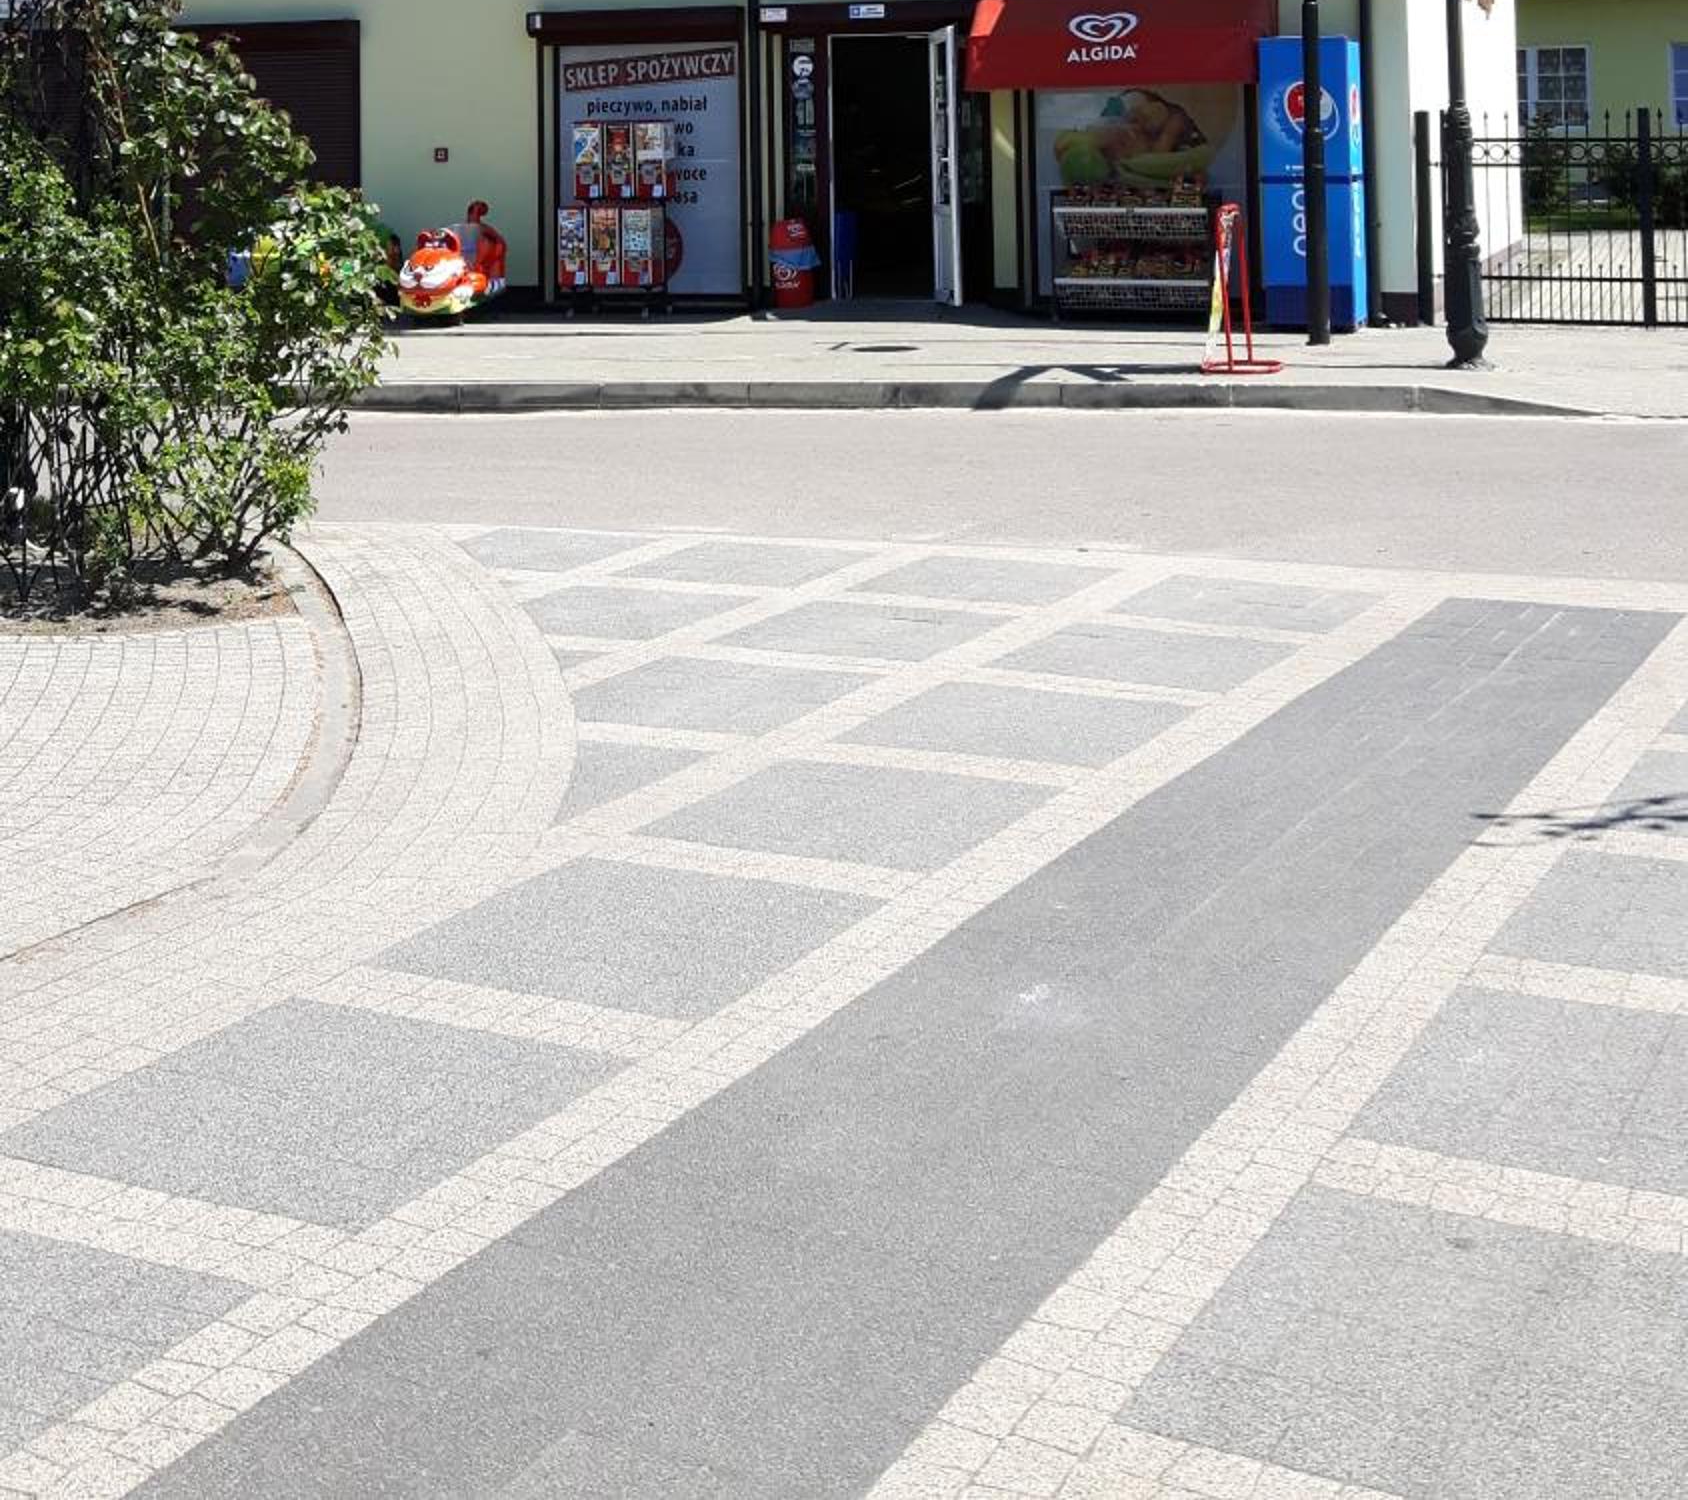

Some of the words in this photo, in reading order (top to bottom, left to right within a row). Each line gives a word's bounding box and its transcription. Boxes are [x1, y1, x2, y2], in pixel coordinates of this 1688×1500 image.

[1067, 44, 1137, 63] ALGIDA
[566, 64, 619, 89] SKLEP
[626, 51, 733, 82] SPOŻYWCZY
[587, 98, 657, 116] pieczywo,
[661, 94, 708, 112] nabiał
[674, 122, 694, 135] wo
[677, 142, 695, 157] ka
